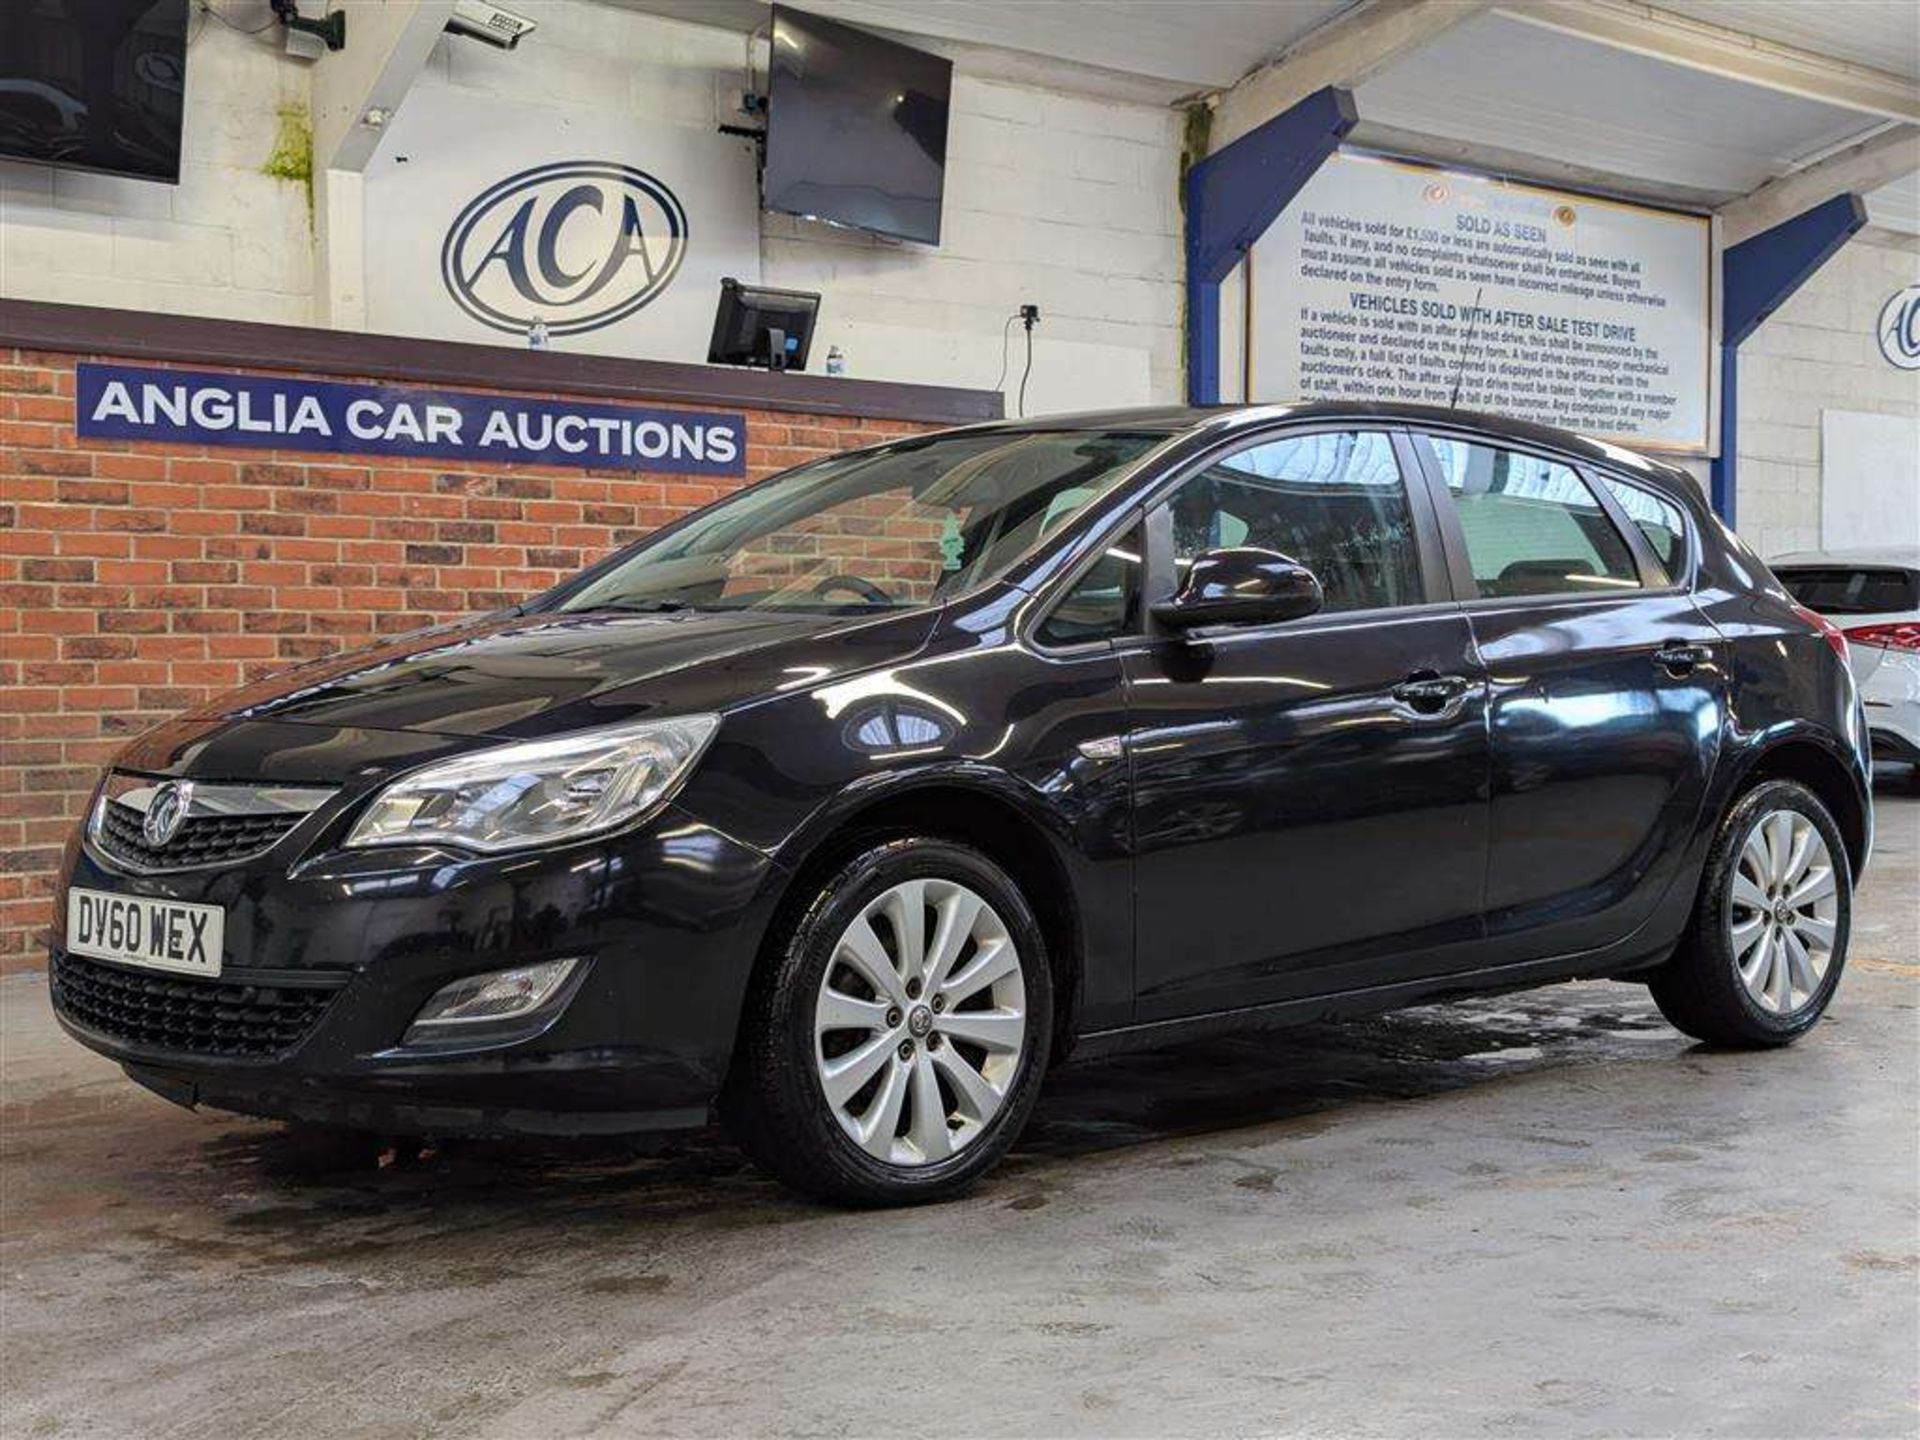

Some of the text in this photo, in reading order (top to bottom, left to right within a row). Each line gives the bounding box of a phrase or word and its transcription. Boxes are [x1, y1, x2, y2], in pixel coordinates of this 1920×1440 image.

[463, 184, 655, 307] ACA
[1301, 211, 1315, 225] All
[1318, 215, 1361, 232] vehicles
[1364, 222, 1387, 236] sold
[1389, 224, 1404, 237] for
[1441, 234, 1451, 244] or
[1454, 235, 1473, 248] less
[1476, 240, 1490, 251] are
[1493, 241, 1552, 262] automatically
[1555, 250, 1573, 263] sold
[1576, 255, 1586, 265] as
[1588, 257, 1609, 269] seen
[1611, 258, 1628, 271] with
[1630, 261, 1641, 273] all
[1456, 213, 1546, 242] SOLD AS SEEN
[1301, 247, 1666, 308] must assume all vehicles sold as seen have incorrect mileage unless otherwise
[1301, 263, 1439, 293] declared on the entry form.
[1304, 229, 1338, 246] faults,
[1340, 233, 1347, 247] if
[1350, 239, 1371, 253] any,
[1374, 240, 1393, 253] and
[1395, 244, 1409, 256] no
[1411, 245, 1463, 263] complaints
[1467, 254, 1519, 270] whatsoever
[1522, 261, 1543, 275] shall
[1545, 265, 1556, 276] be
[1612, 273, 1641, 289] Buyers
[1301, 307, 1308, 320] If
[1311, 311, 1317, 321] a
[1320, 310, 1358, 326] vehicle
[1360, 315, 1370, 327] is
[1372, 317, 1395, 330] sold
[1397, 320, 1418, 332] with
[1421, 323, 1433, 334] an
[1435, 323, 1457, 336] after
[1480, 329, 1499, 342] test
[1501, 331, 1528, 346] drive,
[1529, 333, 1546, 347] this
[1548, 336, 1570, 350] shall
[1572, 340, 1583, 351] be
[1585, 341, 1631, 357] announced
[1633, 346, 1643, 360] by
[1645, 347, 1658, 359] the
[1350, 292, 1636, 342] VEHICLES SOLD WITH AFTER SALE TEST DRIVE
[1301, 327, 1669, 376] auctioneer and declared on the entry form. A test drive covers major mechanical
[1301, 341, 1649, 389] faults only, a full list of faults covered is displayed in the office and with the
[1301, 361, 1364, 378] auctioneer's
[1366, 365, 1394, 380] clerk.
[1398, 367, 1417, 381] The
[1419, 370, 1442, 384] after
[1443, 374, 1461, 387] sale
[1465, 374, 1484, 388] test
[1485, 377, 1509, 391] drive
[1511, 380, 1535, 393] must
[1536, 380, 1548, 393] be
[1550, 382, 1576, 397] taken
[1579, 385, 1616, 401] together
[1617, 388, 1635, 401] with
[1643, 391, 1677, 406] member
[1301, 376, 1312, 389] of
[1313, 378, 1340, 391] staff,
[1343, 380, 1375, 395] within
[1377, 385, 1396, 397] one
[1398, 385, 1421, 399] hour
[1424, 386, 1446, 401] from
[1466, 391, 1481, 403] fall
[1483, 392, 1493, 405] of
[1494, 393, 1510, 405] the
[1553, 398, 1569, 412] Any
[1571, 401, 1617, 417] complaints
[1620, 405, 1629, 417] of
[1630, 407, 1645, 420] any
[1647, 407, 1670, 422] major
[92, 381, 737, 463] ANGLIA CAR AUCTIONS
[1559, 416, 1580, 428] from
[1582, 417, 1595, 429] the
[1598, 418, 1614, 430] test
[78, 895, 208, 964] DV60 WEX
